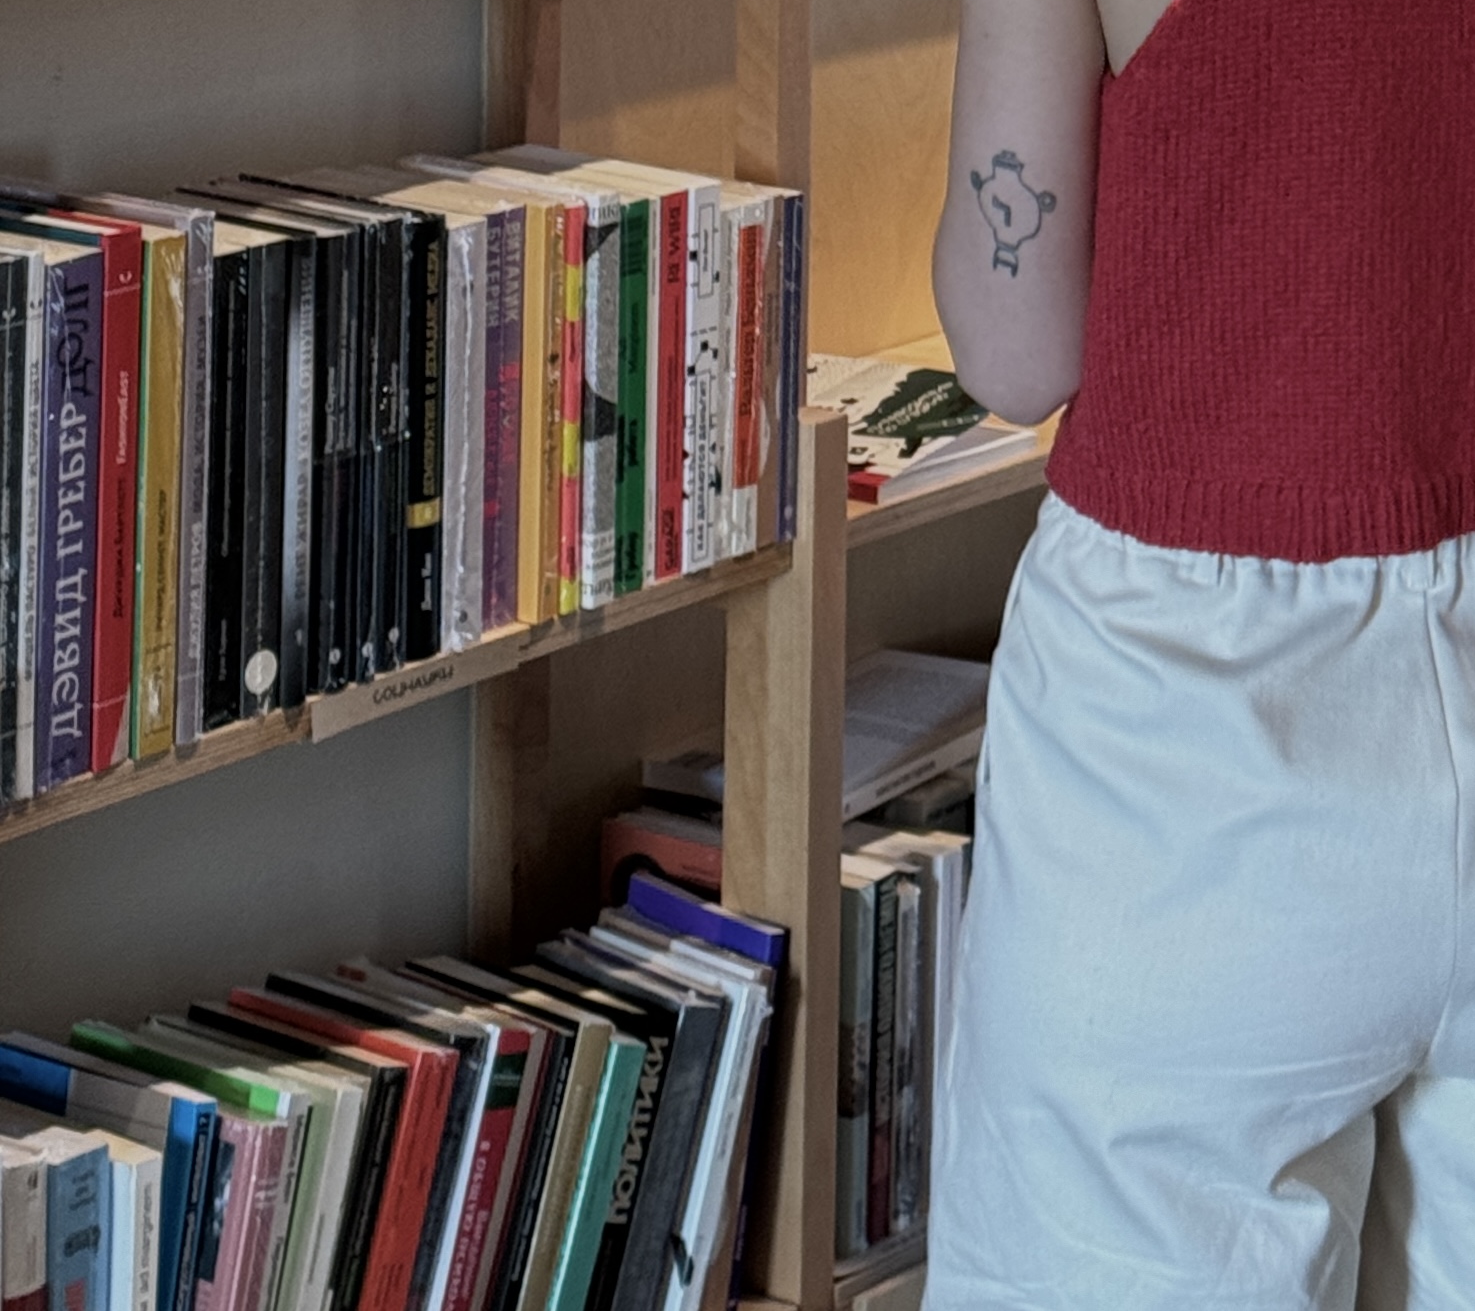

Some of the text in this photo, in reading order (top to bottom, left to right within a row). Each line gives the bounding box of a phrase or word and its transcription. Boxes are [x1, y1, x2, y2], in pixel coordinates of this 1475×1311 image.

[485, 225, 501, 328] БУТЕРИН
[503, 220, 522, 323] ВИТАЛИК
[51, 278, 95, 740] ДЭВИД ГРЕБЕР ДОЛГ
